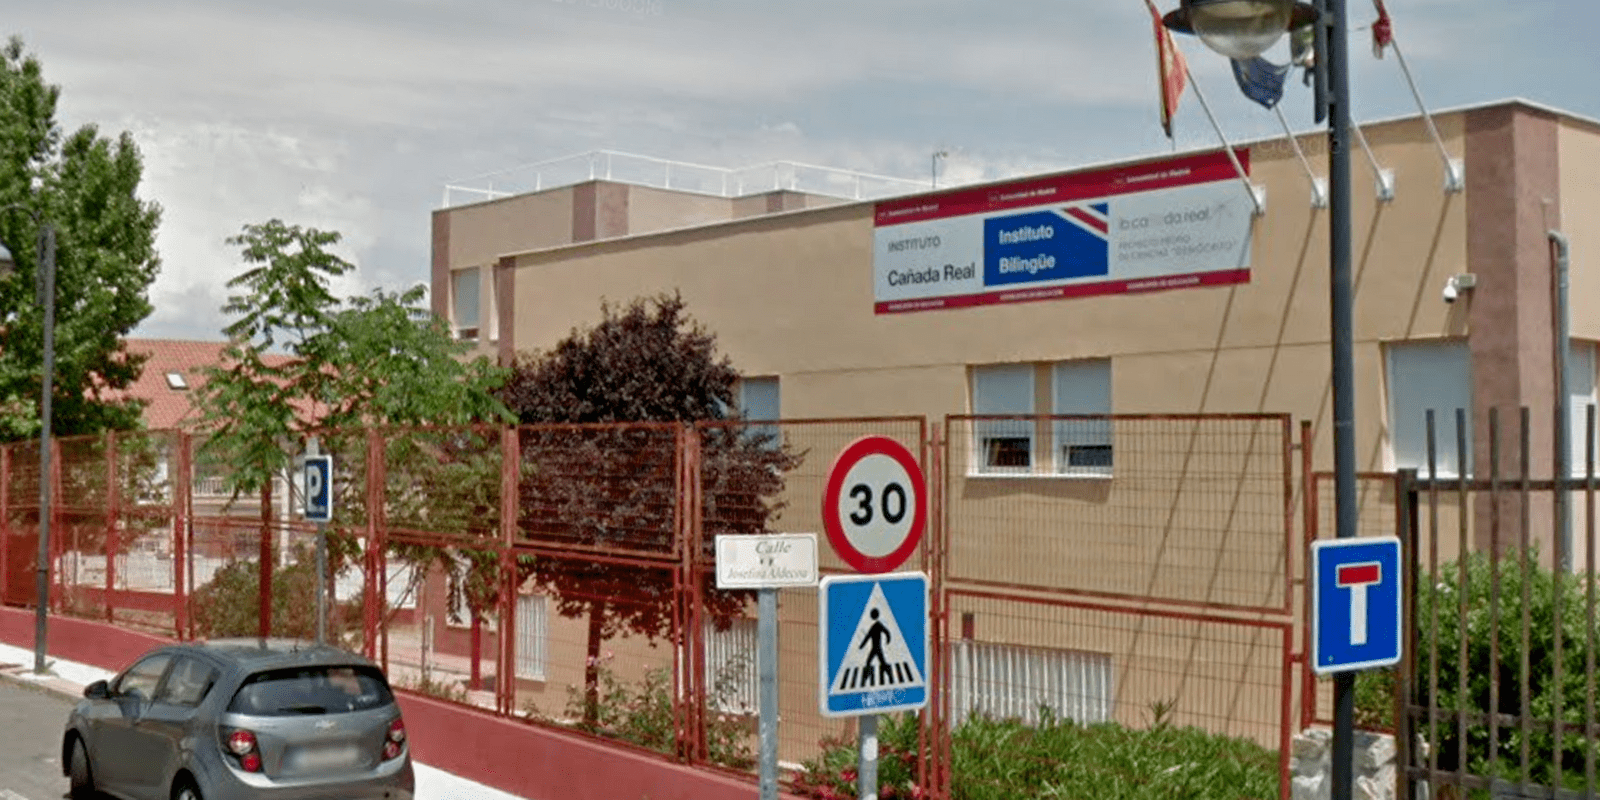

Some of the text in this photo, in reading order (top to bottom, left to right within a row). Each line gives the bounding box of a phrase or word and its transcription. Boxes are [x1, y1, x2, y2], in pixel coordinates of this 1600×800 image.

[887, 235, 942, 254] INSTITUTO
[998, 224, 1055, 245] Instituto
[887, 261, 976, 286] Cañada Real
[998, 253, 1056, 275] Bilingüe
[849, 481, 907, 527] 30
[755, 540, 792, 554] Calle
